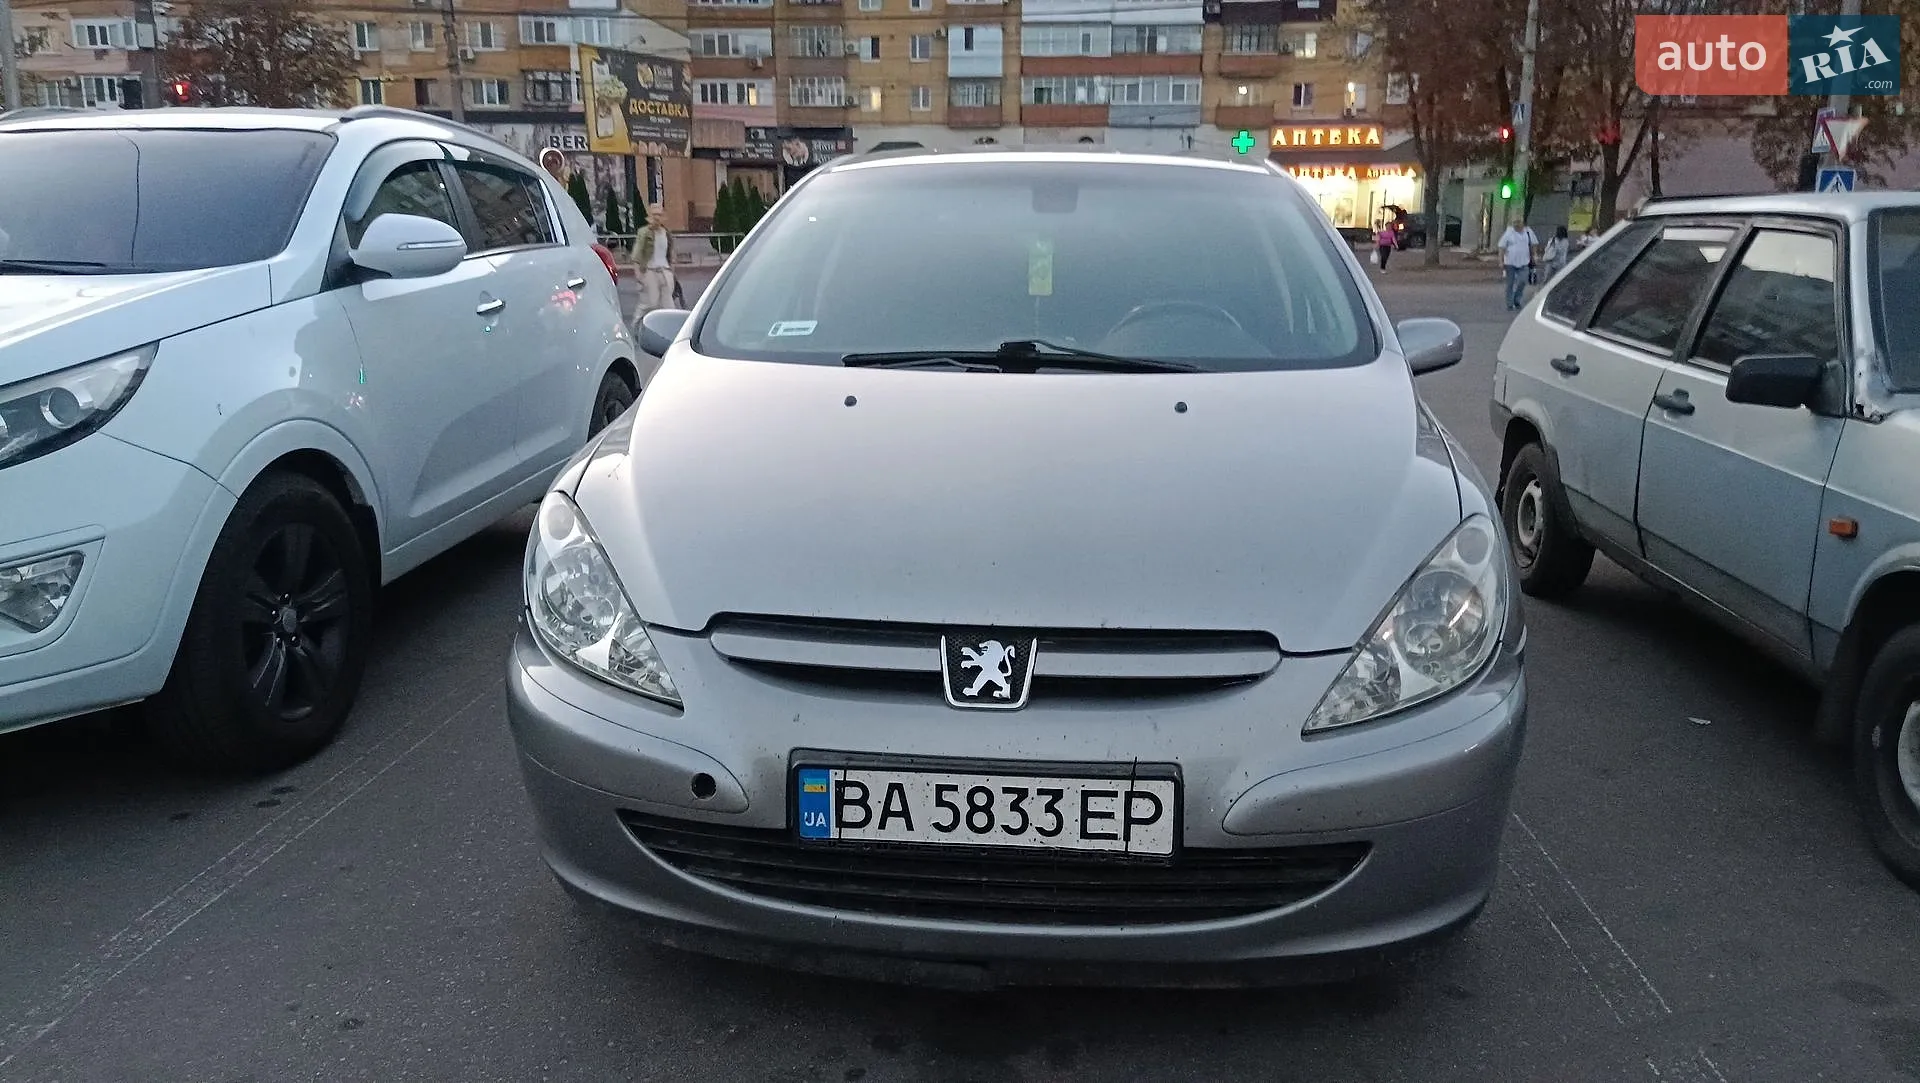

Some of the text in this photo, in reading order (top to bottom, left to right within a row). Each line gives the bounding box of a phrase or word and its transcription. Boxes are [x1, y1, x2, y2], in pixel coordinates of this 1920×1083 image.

[629, 98, 690, 118] ДОСТАВКА
[1272, 127, 1380, 146] АПТЕКА
[804, 811, 828, 828] UA
[834, 779, 1164, 842] BA 5833 EP
